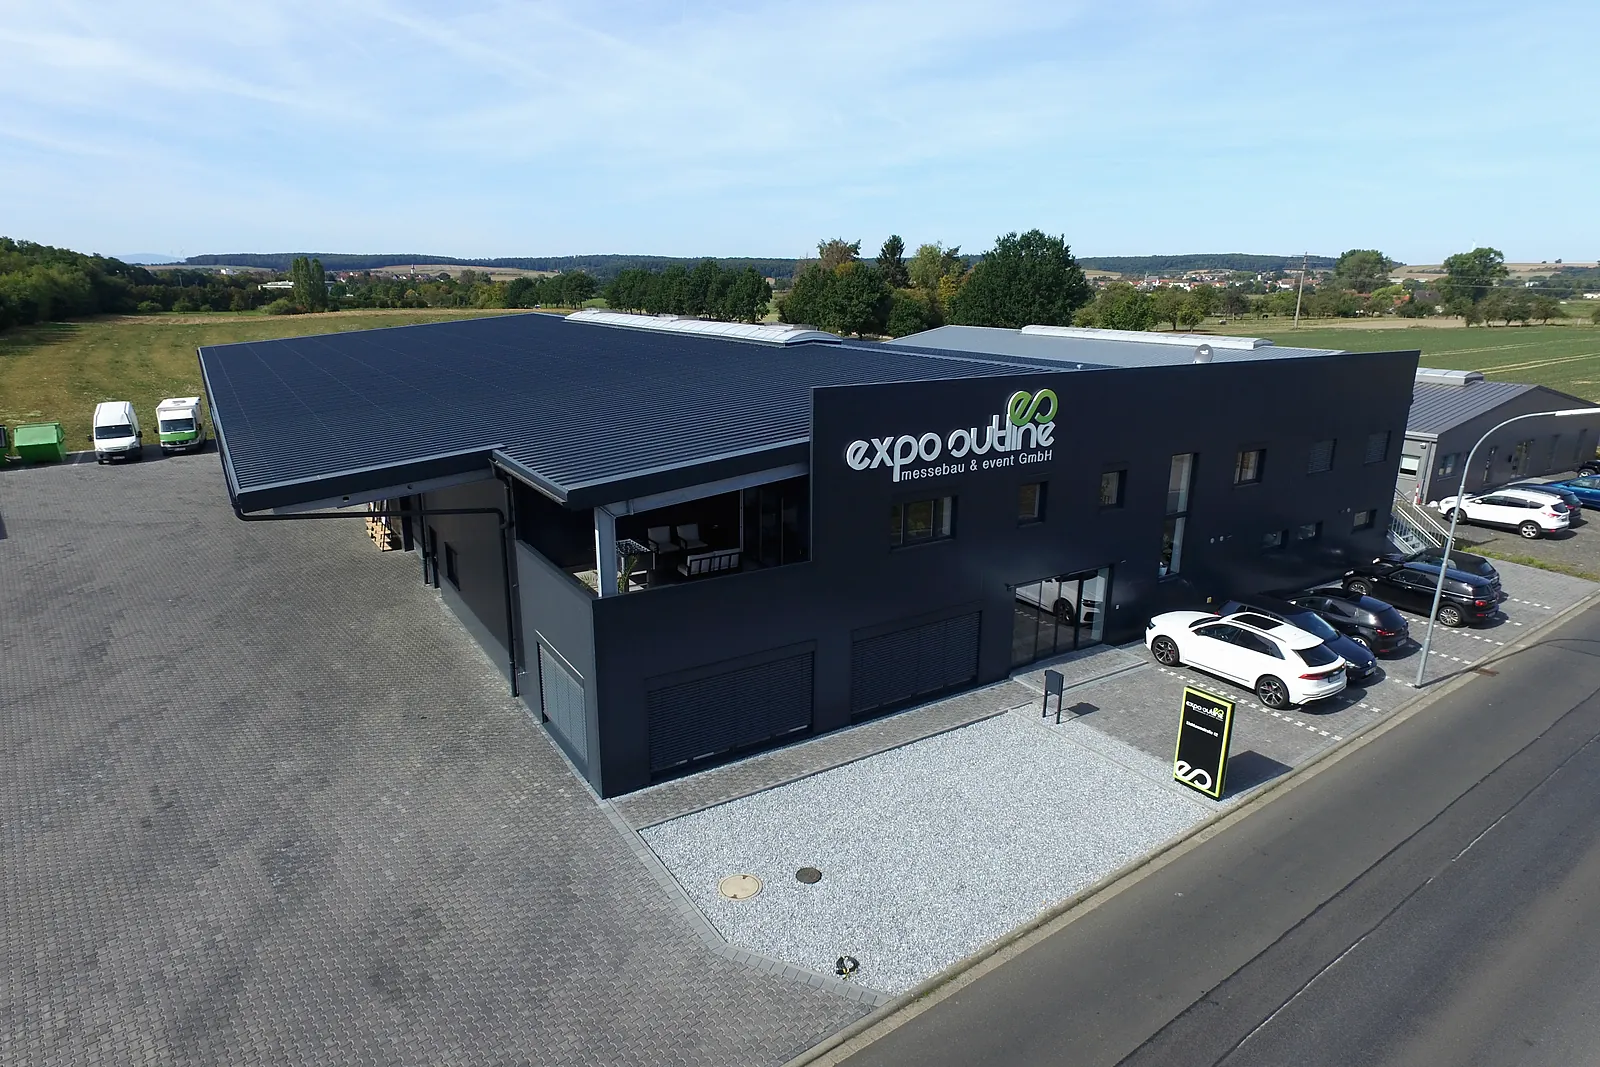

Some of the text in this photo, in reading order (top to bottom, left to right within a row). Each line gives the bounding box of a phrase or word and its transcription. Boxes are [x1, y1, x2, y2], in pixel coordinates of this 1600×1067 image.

[846, 414, 1056, 482] expo outline
[901, 450, 1053, 481] messebau & event GmbH
